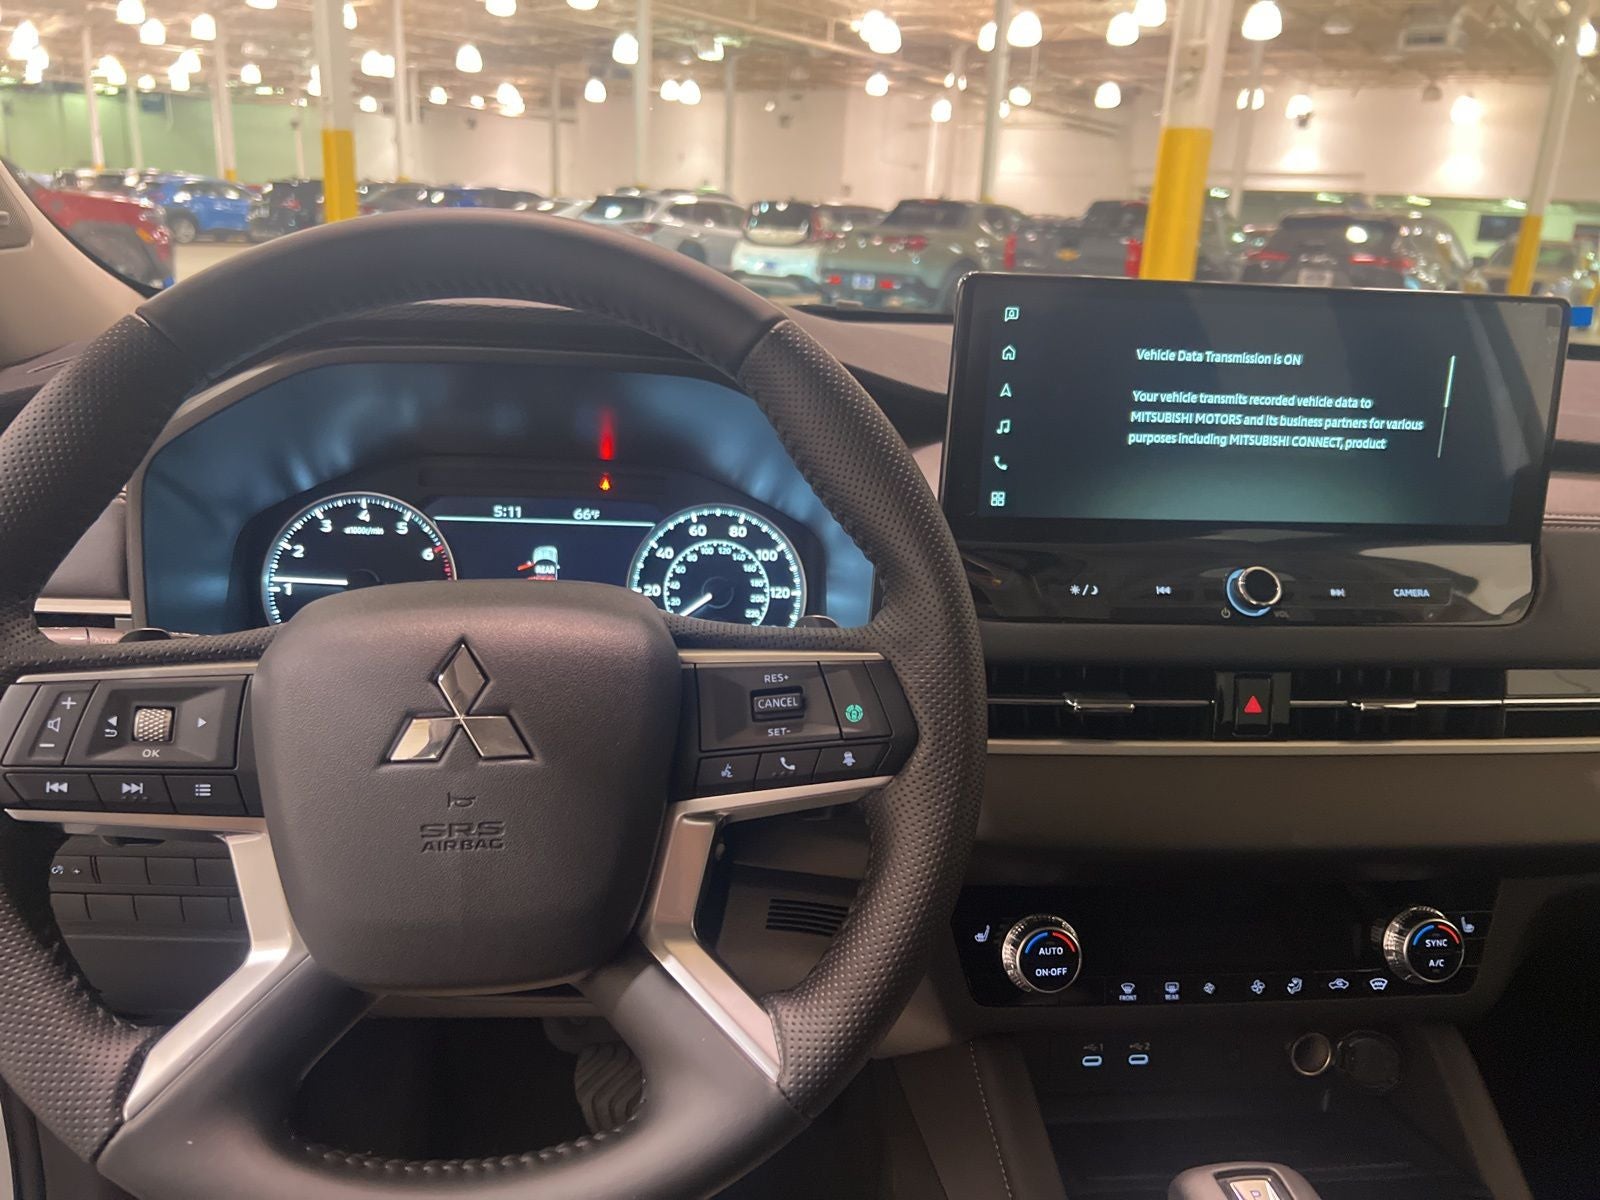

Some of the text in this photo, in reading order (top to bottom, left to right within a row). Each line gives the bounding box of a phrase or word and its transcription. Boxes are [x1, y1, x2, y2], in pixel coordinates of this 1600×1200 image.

[1136, 348, 1303, 366] Vehicle Data Transmission is ON
[1132, 390, 1373, 409] Your vehicle transmits recorded vehicle data to
[1130, 411, 1424, 431] MITSUBISHI MOTORS and its business partners for various
[1128, 433, 1387, 450] purposes including MITSUBISHI CONNECT, product
[357, 509, 370, 522] 4
[493, 505, 522, 518] 5:11
[320, 520, 332, 532] 3
[396, 522, 408, 534] 5
[689, 525, 707, 537] 60
[728, 525, 747, 538] 80
[292, 545, 304, 557] 2
[421, 548, 434, 560] 6
[656, 547, 674, 559] 40
[701, 547, 714, 555] 100
[718, 547, 731, 555] 120
[733, 553, 746, 561] 140
[756, 549, 778, 562] 100
[284, 583, 292, 595] 1
[643, 585, 661, 597] 20
[770, 587, 790, 599] 120
[1393, 588, 1430, 598] CAMERA
[764, 673, 790, 684] RES+
[757, 697, 799, 709] CANCEL
[142, 748, 161, 758] OK
[420, 821, 505, 838] SRS
[421, 838, 505, 853] AIRBAG
[1425, 938, 1448, 948] SYNC
[1038, 946, 1064, 956] AUTO
[1428, 958, 1445, 968] A/C
